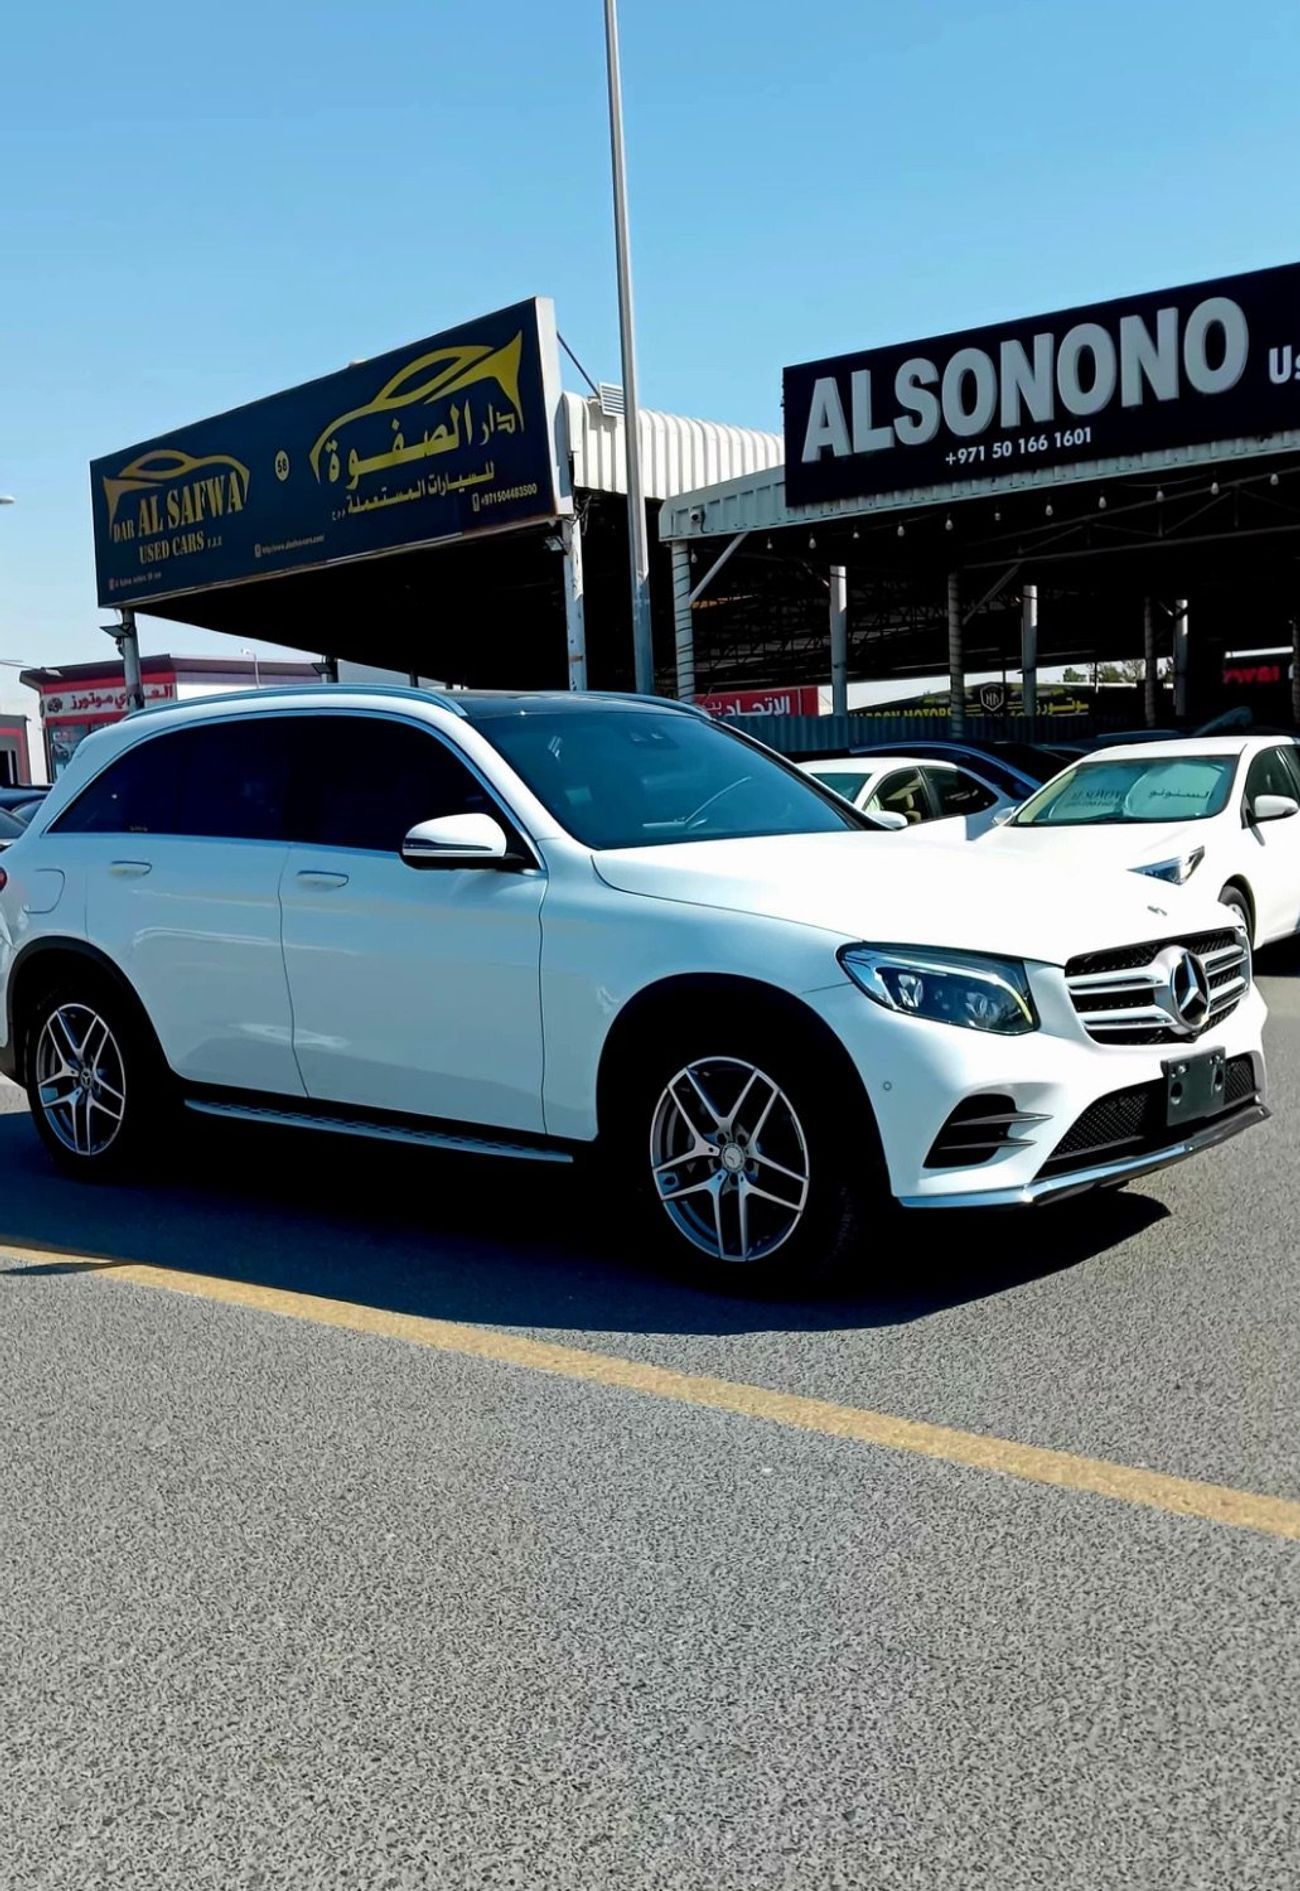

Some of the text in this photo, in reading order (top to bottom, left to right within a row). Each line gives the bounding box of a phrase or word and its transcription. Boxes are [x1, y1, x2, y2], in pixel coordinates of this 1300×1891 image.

[801, 297, 1249, 463] ALSONONO
[324, 399, 516, 490] دار الصفوة
[945, 427, 1091, 465] +971 50 166 1601
[277, 458, 288, 474] 58
[428, 461, 495, 496] للسيارات
[113, 471, 243, 543] DAR AL SAFWA
[347, 479, 426, 514] المستعملة
[139, 539, 170, 564] USED
[172, 531, 204, 556] CARS
[71, 692, 113, 710] موتورز
[724, 695, 790, 717] الاتحاد
